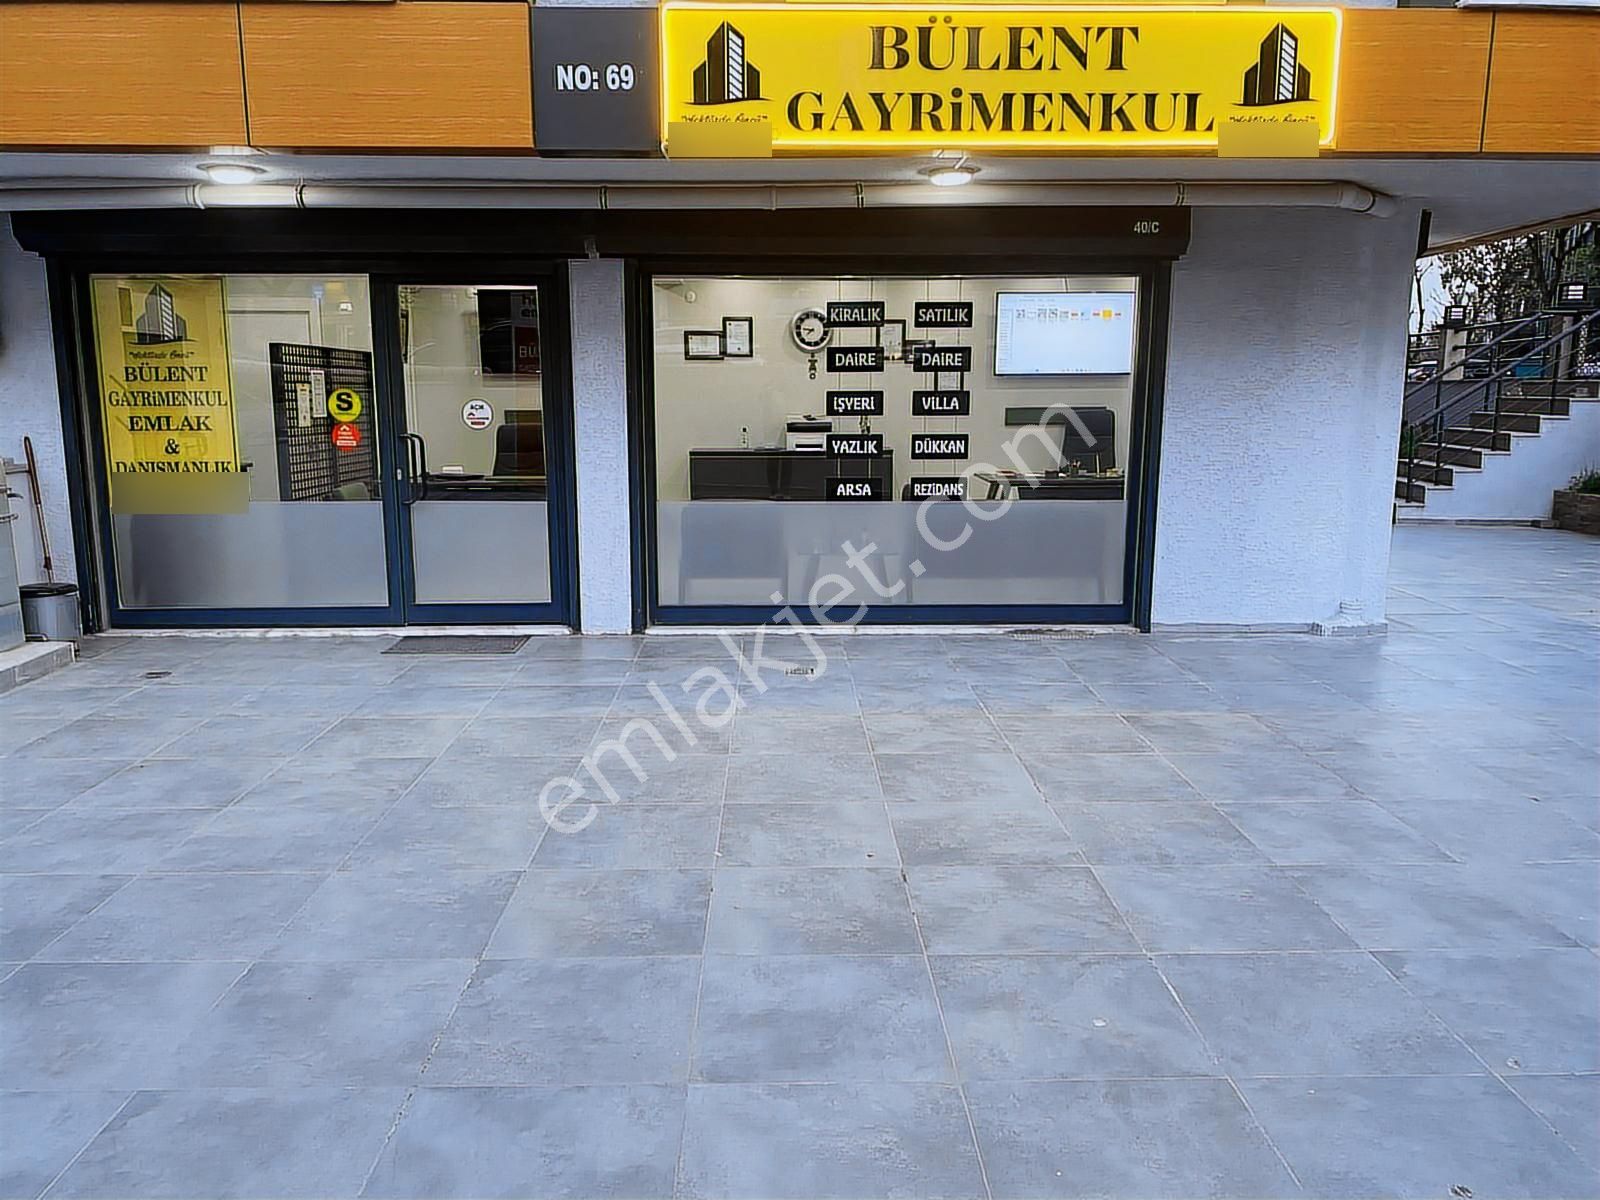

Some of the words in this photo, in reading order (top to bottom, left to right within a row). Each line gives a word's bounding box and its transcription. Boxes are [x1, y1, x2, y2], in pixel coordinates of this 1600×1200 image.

[867, 16, 1139, 72] BÜLENT
[556, 65, 600, 91] NO:
[605, 64, 634, 91] 69
[1133, 221, 1160, 234] 40/C
[918, 308, 969, 322] SATILIK
[123, 362, 209, 383] BÜLENT
[336, 391, 353, 411] S
[128, 415, 213, 432] EMLAK
[164, 438, 181, 455] &
[832, 440, 878, 454] YAZLIK
[914, 438, 965, 454] DÜKKAN
[836, 483, 872, 496] ARSA
